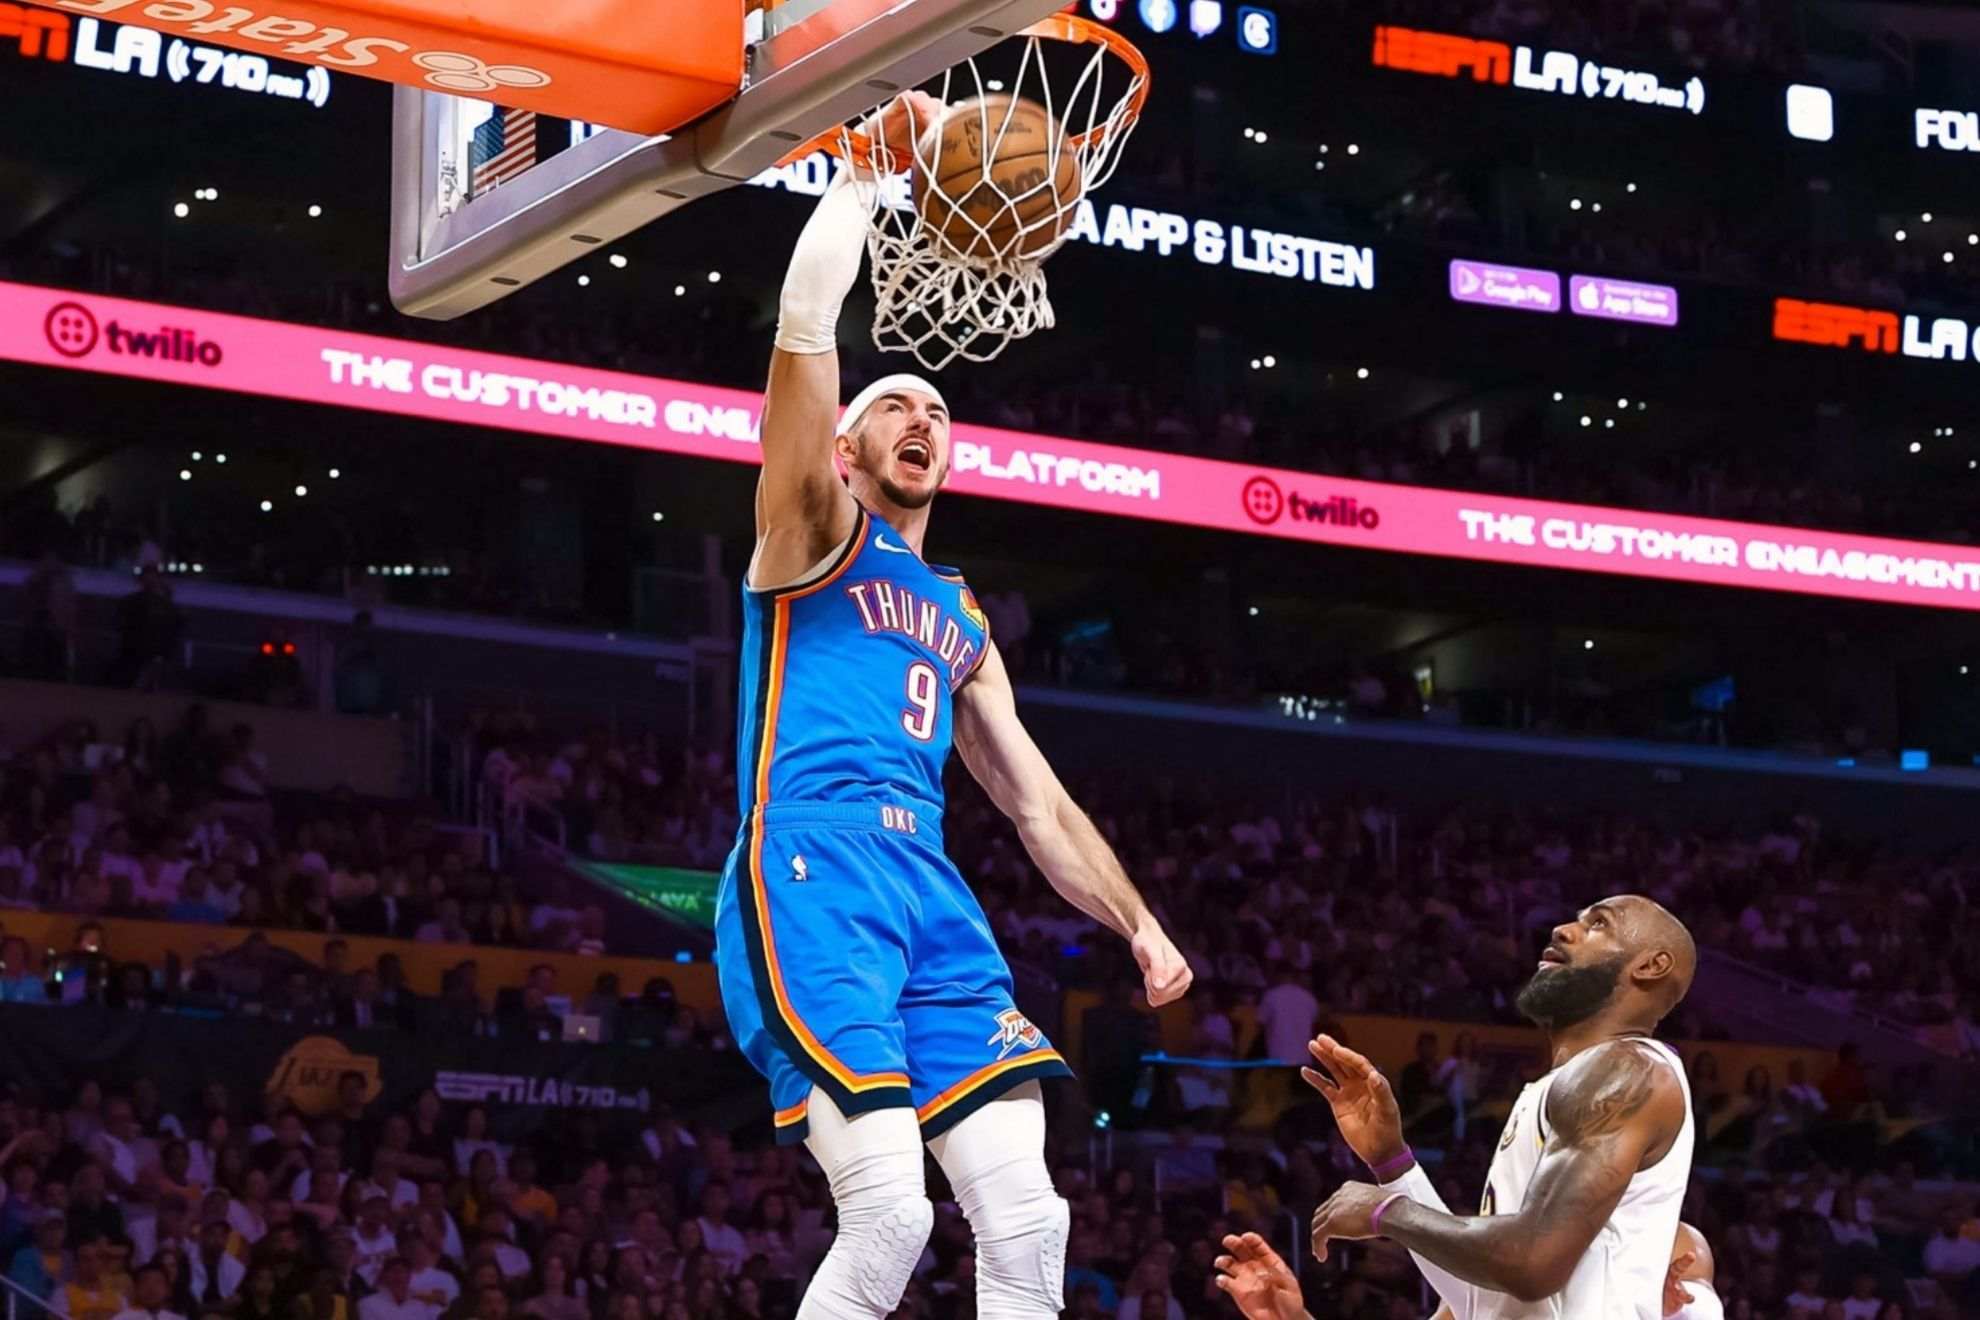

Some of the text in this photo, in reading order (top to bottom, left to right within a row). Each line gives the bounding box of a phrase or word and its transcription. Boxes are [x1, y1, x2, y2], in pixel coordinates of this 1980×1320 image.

[74, 17, 162, 77] LA
[143, 0, 408, 67] State
[1374, 26, 1511, 84] ESPN
[1513, 45, 1578, 95] LA
[1103, 204, 1188, 255] APP
[1194, 219, 1226, 264] &
[1232, 226, 1374, 289] LISTEN
[105, 320, 223, 367] twilio
[1774, 298, 1968, 361] ESPN LA
[321, 349, 413, 393] THE
[421, 365, 656, 428] CUSTOMER
[953, 442, 1160, 499] PLATFORM
[1288, 491, 1379, 530] twilio
[1459, 509, 1535, 546] THE
[1542, 520, 1738, 567] CUSTOMER
[848, 579, 974, 686] THUNDE
[901, 659, 939, 741] 9
[881, 806, 917, 834] OKC
[435, 1070, 526, 1103] ESPN
[527, 1076, 560, 1105] LA
